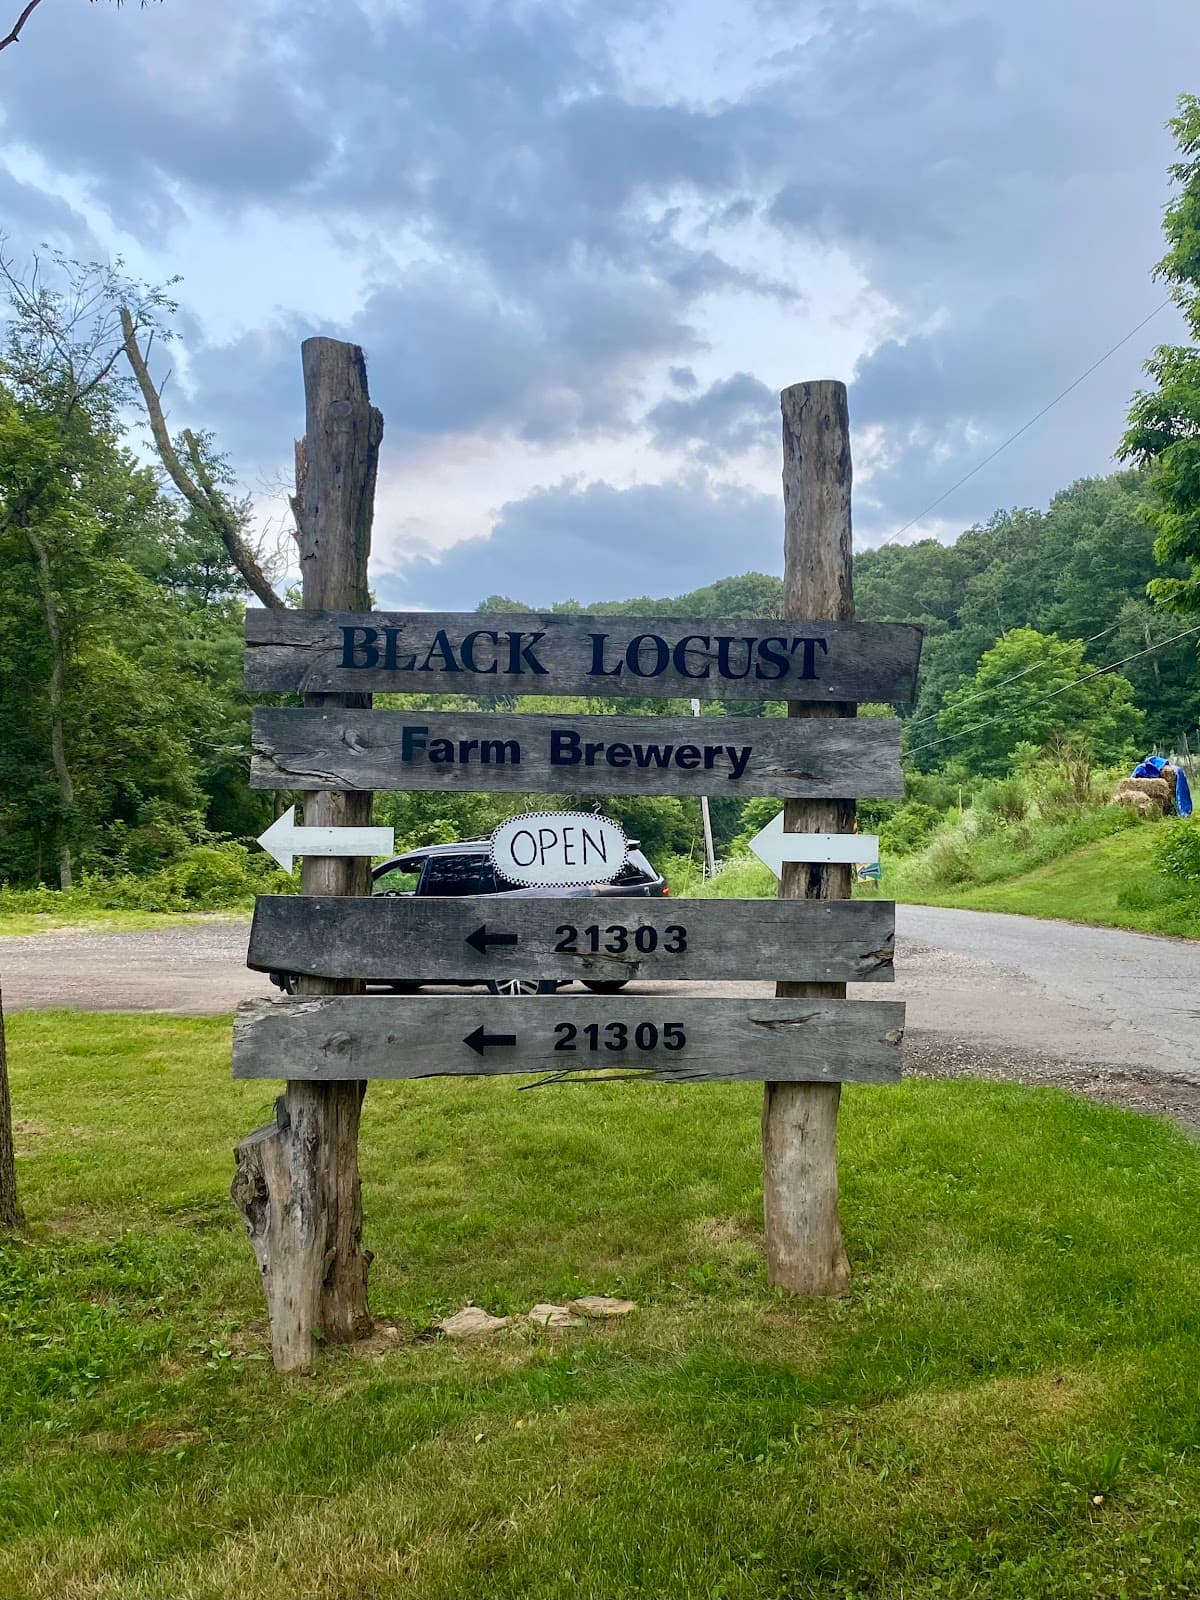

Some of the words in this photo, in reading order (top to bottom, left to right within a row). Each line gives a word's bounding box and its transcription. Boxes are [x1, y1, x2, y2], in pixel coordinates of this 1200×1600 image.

[336, 626, 549, 675] BLACK
[586, 634, 828, 680] LOCUST
[402, 726, 521, 764] Farm
[550, 729, 752, 779] Brewery
[510, 827, 608, 867] OPEN
[554, 925, 688, 953] 21303
[553, 1022, 686, 1051] 21305
